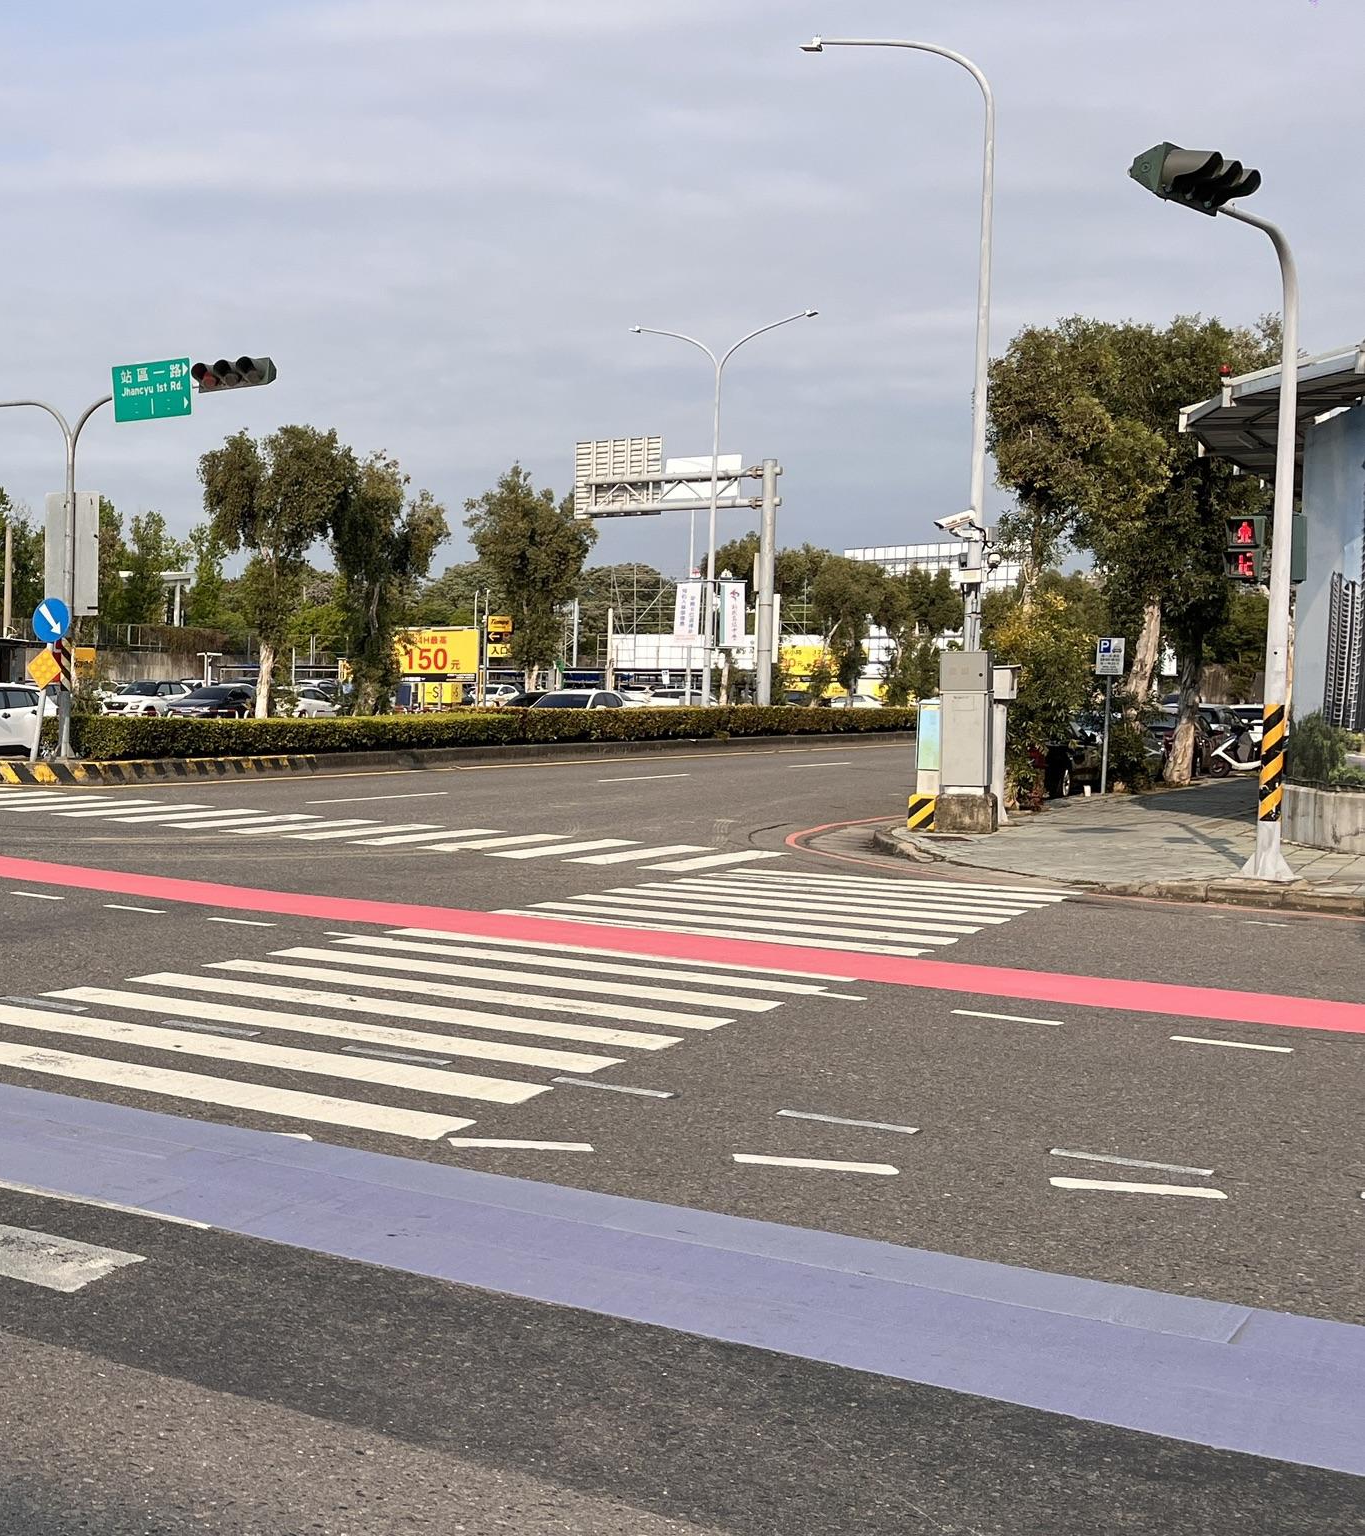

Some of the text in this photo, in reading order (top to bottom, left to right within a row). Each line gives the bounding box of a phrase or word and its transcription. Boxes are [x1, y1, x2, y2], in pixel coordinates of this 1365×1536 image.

[120, 363, 181, 383] 站區一路
[121, 385, 154, 397] Jhancyu
[170, 380, 183, 391] Rd.
[491, 646, 508, 655] 入口
[1100, 640, 1110, 652] P
[407, 648, 448, 671] 150
